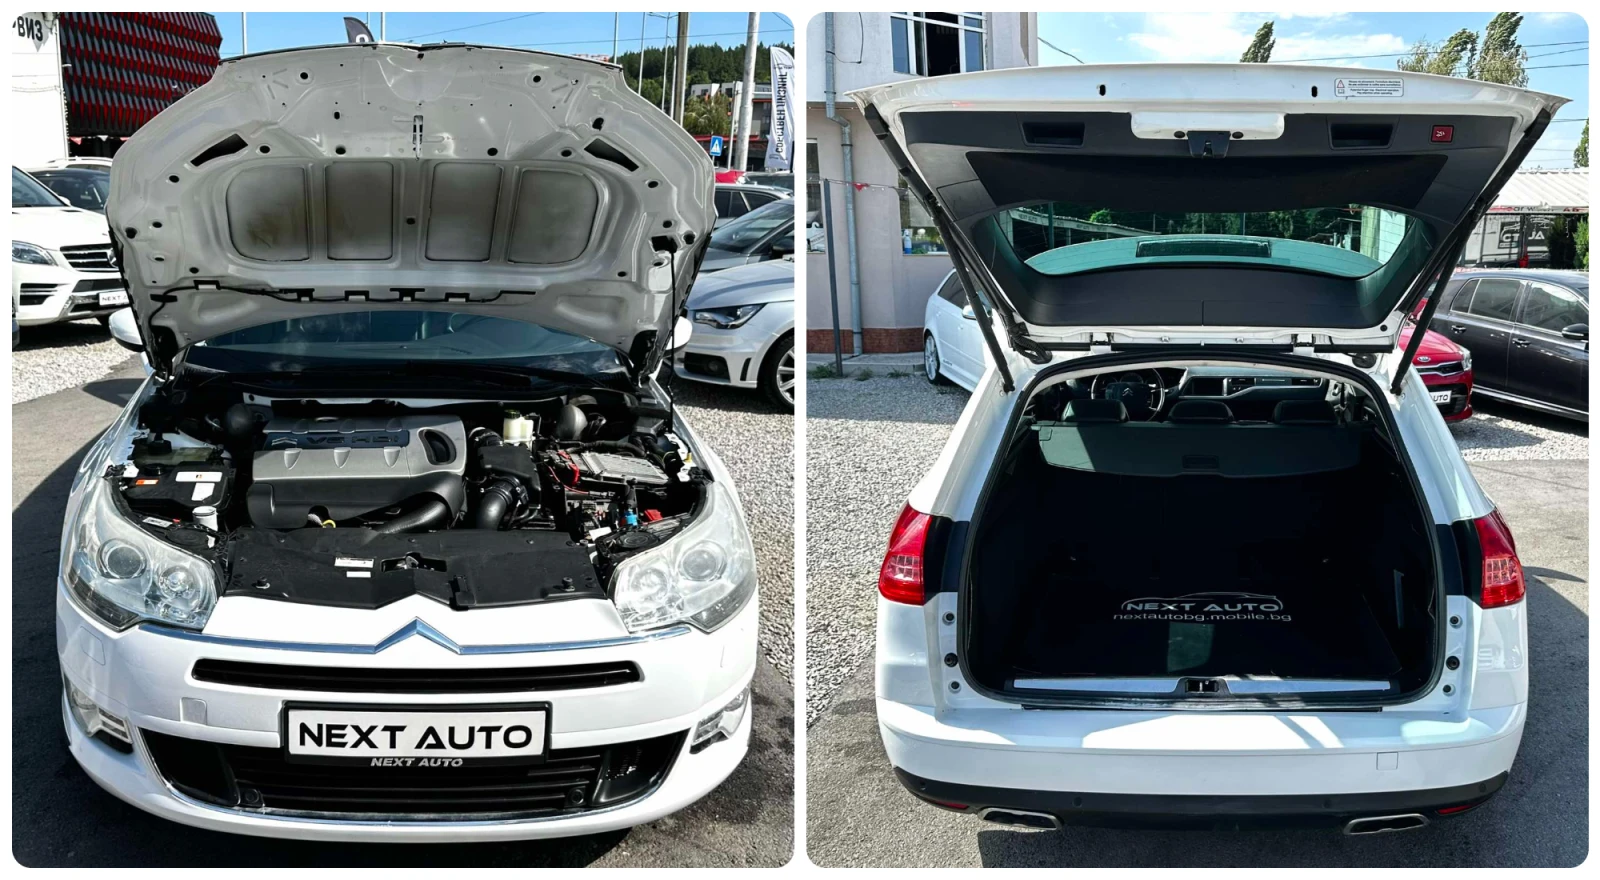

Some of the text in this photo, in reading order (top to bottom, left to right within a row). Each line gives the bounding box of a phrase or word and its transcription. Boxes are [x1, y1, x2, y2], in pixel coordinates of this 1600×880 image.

[12, 16, 44, 42] ВИЗ
[1431, 394, 1449, 402] UTO
[1126, 602, 1280, 612] NEXT AUTO
[1113, 612, 1292, 622] nextautobg.mobile.bg
[299, 721, 533, 750] NEXT AUTO
[370, 757, 463, 768] NEXT AUTO
